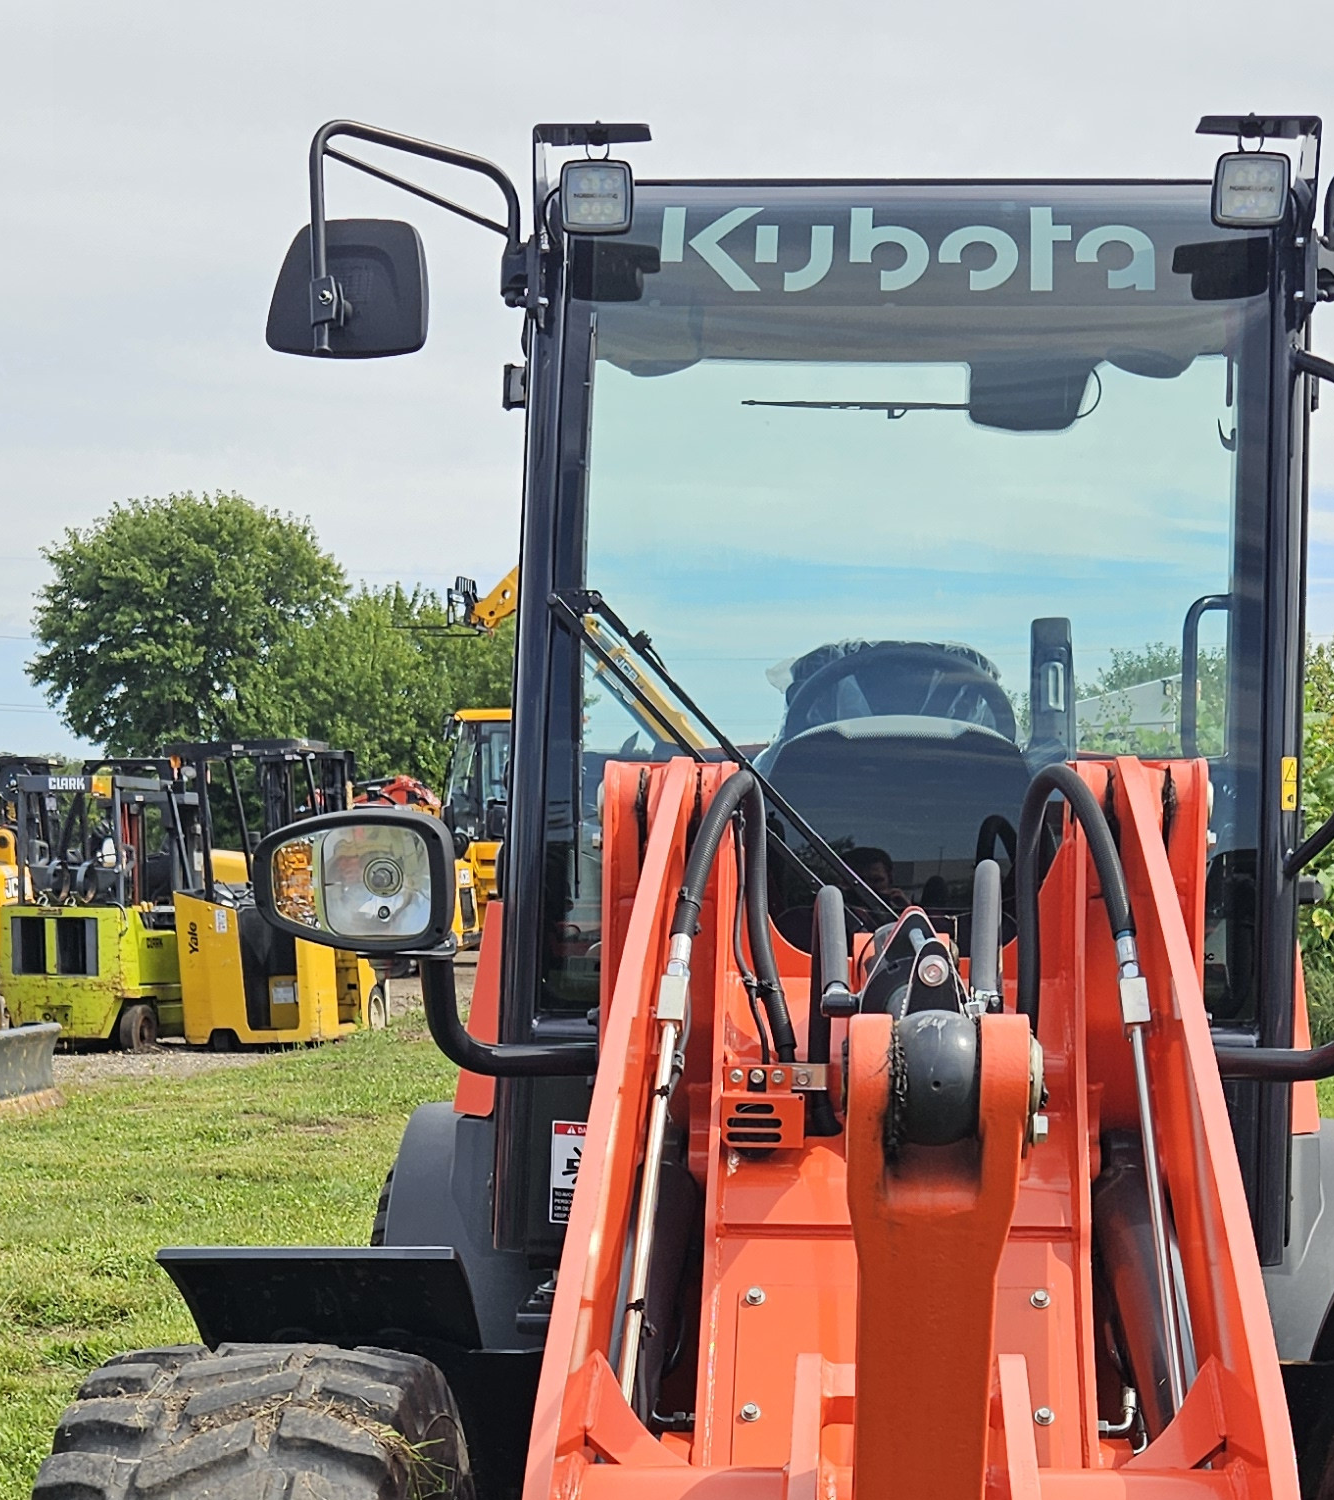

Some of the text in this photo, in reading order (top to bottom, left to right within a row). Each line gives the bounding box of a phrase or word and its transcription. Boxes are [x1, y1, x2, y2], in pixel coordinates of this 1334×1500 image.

[660, 206, 1155, 291] Kubota
[615, 656, 638, 682] JCB
[48, 777, 85, 790] CLARK
[187, 921, 199, 954] Yale
